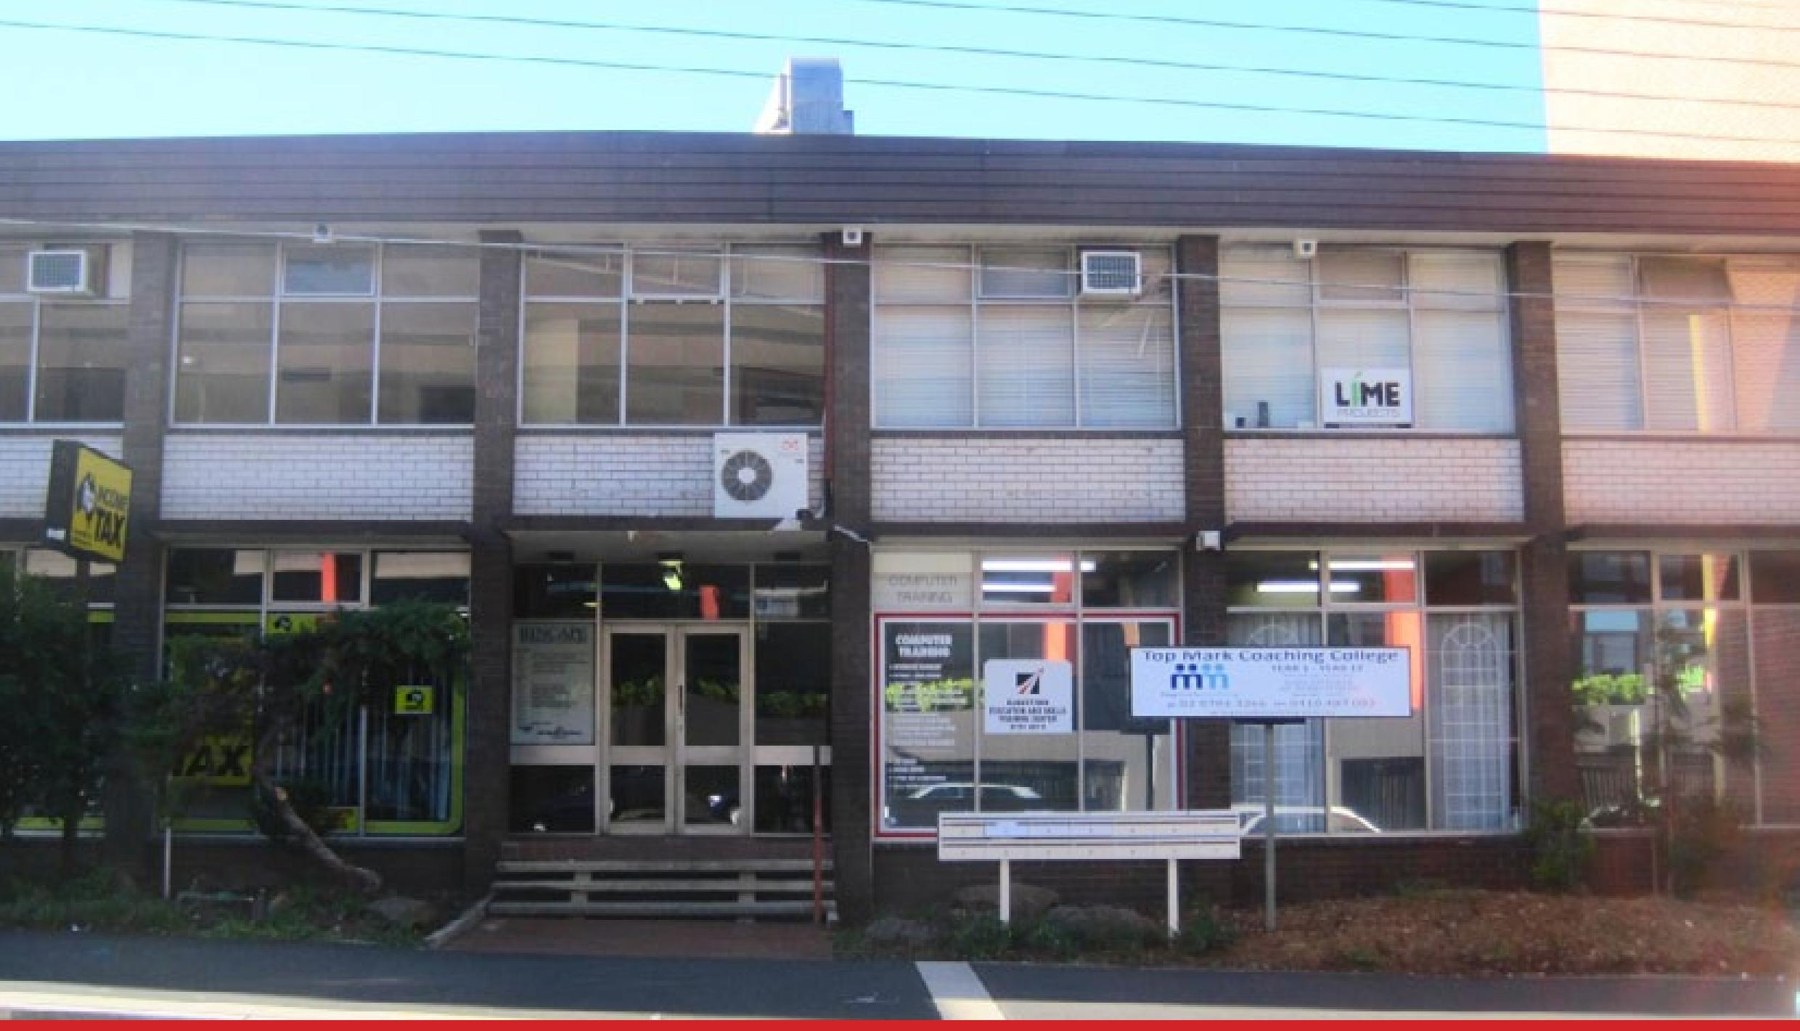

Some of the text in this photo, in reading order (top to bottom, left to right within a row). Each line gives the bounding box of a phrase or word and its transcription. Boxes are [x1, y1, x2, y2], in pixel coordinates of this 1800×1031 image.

[94, 507, 126, 549] TAX
[1143, 650, 1399, 664] Top Mark Coaching College
